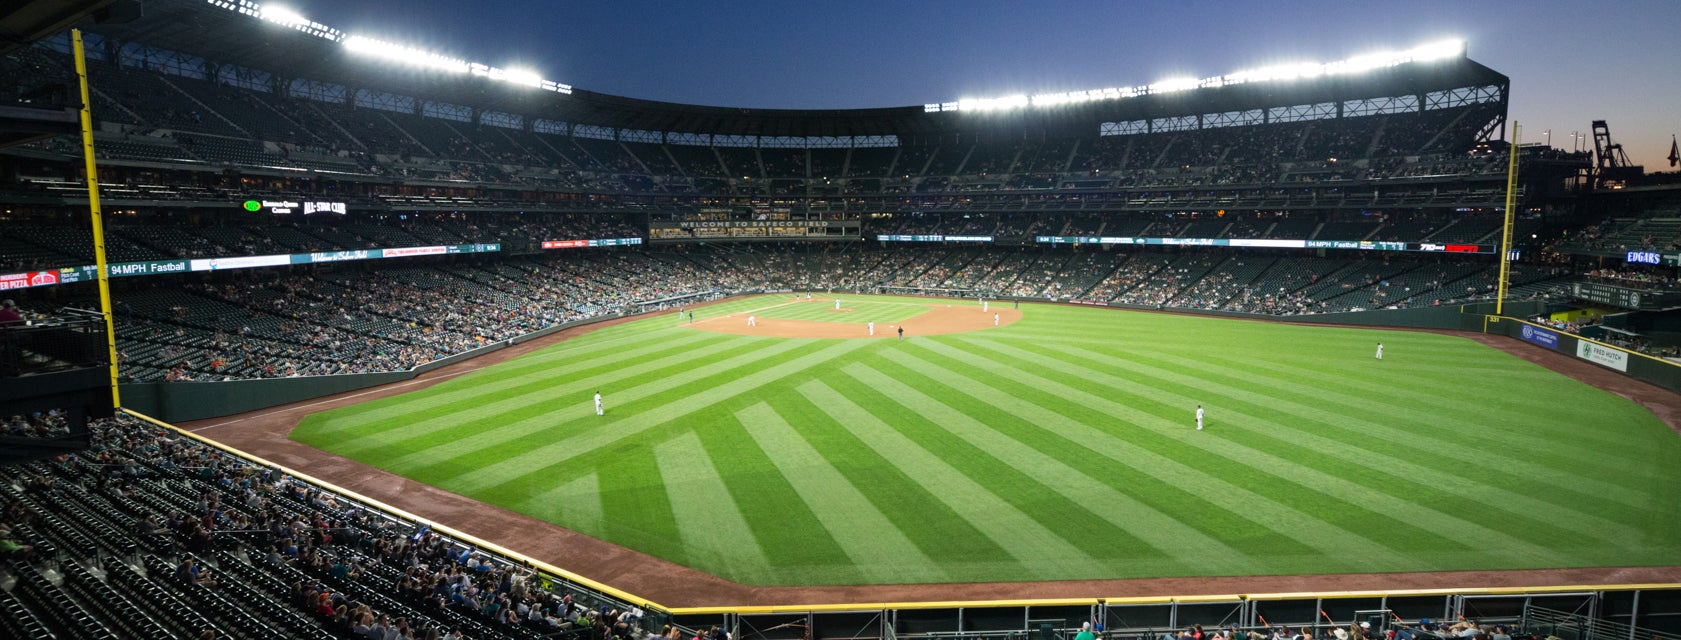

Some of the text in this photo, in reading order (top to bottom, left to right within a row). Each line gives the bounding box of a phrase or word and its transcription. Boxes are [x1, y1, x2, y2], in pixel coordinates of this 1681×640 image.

[331, 202, 346, 215] CLUB
[1627, 251, 1660, 264] EDGARS
[111, 262, 185, 275] 94 MPH Fastball
[10, 280, 29, 289] PIZZA
[1593, 347, 1605, 356] FRED
[1605, 351, 1622, 361] HUTCH
